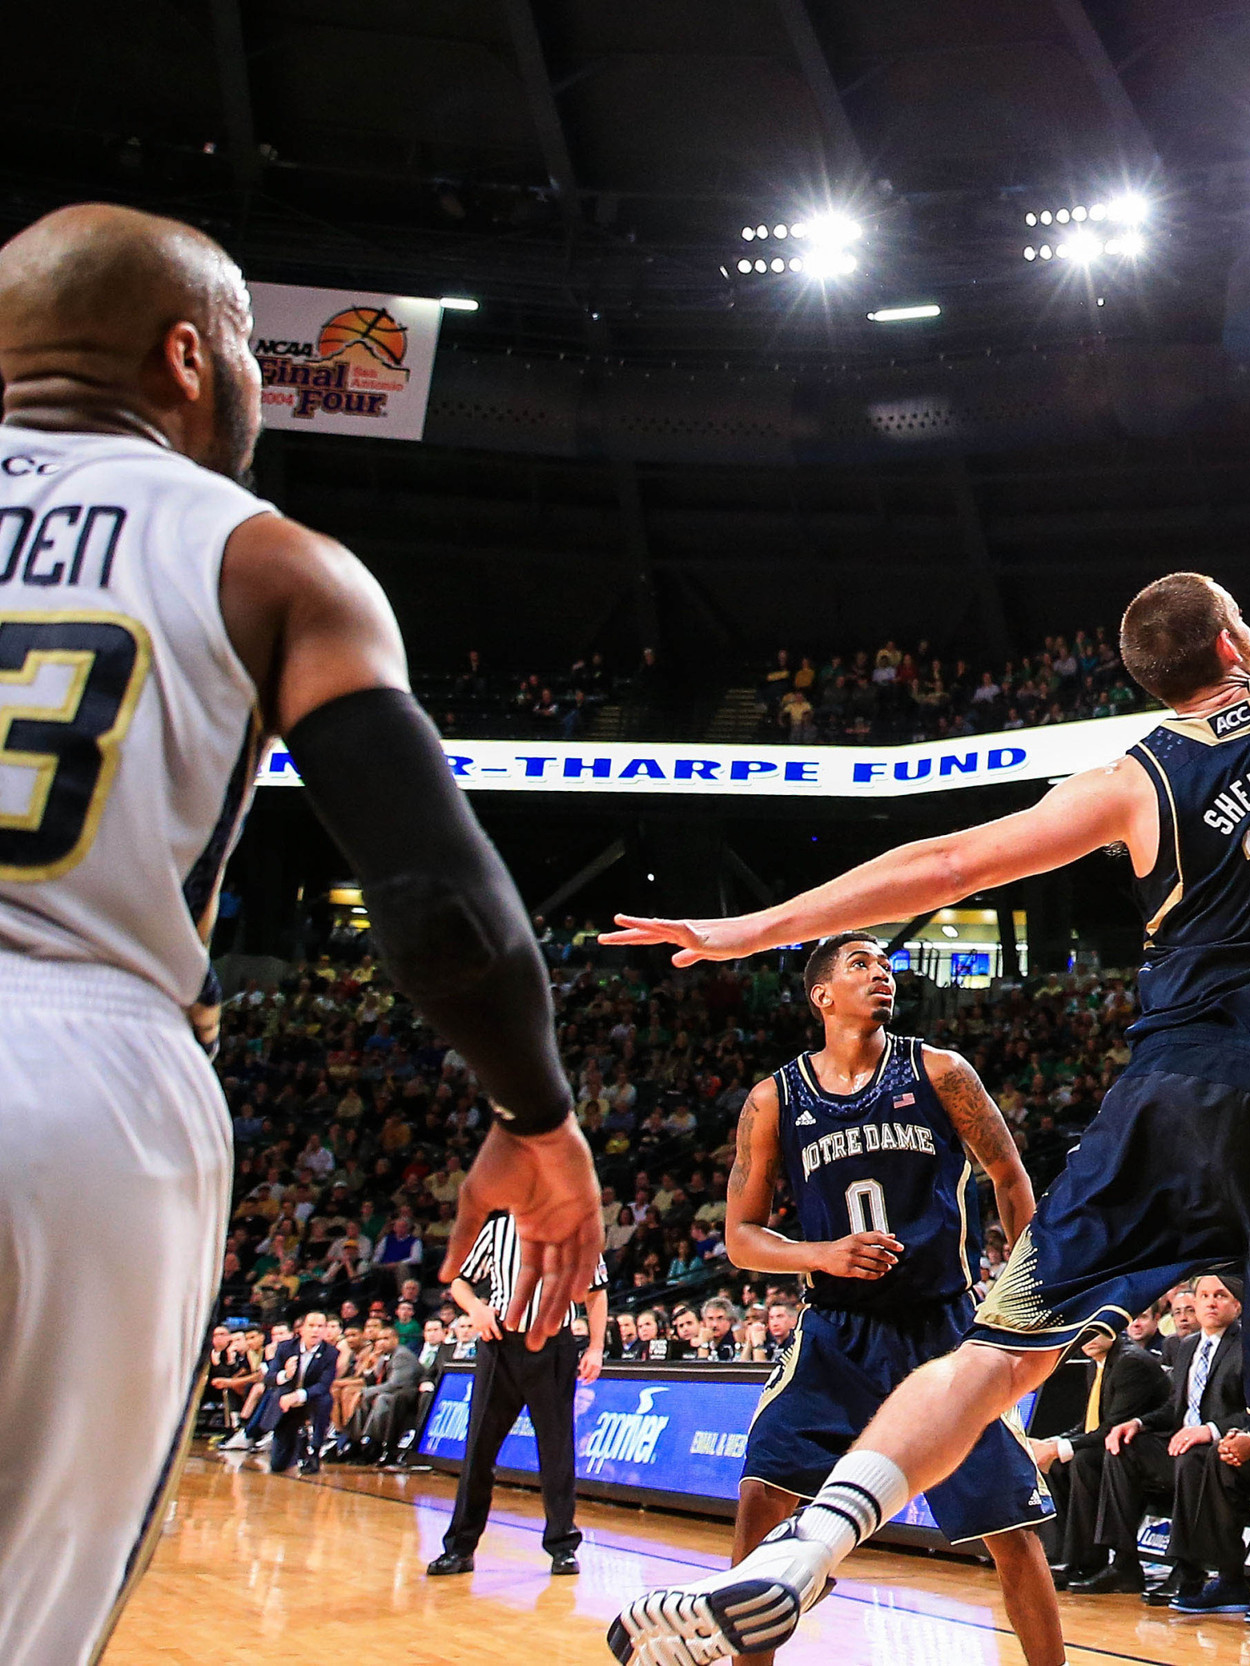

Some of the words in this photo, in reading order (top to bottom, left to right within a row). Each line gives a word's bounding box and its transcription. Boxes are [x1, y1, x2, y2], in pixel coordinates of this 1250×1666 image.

[256, 339, 312, 356] NCAA
[259, 357, 349, 389] Final
[293, 388, 388, 419] Four
[852, 747, 1028, 783] FUND
[864, 1122, 937, 1156] DAME
[844, 1178, 891, 1240] 0
